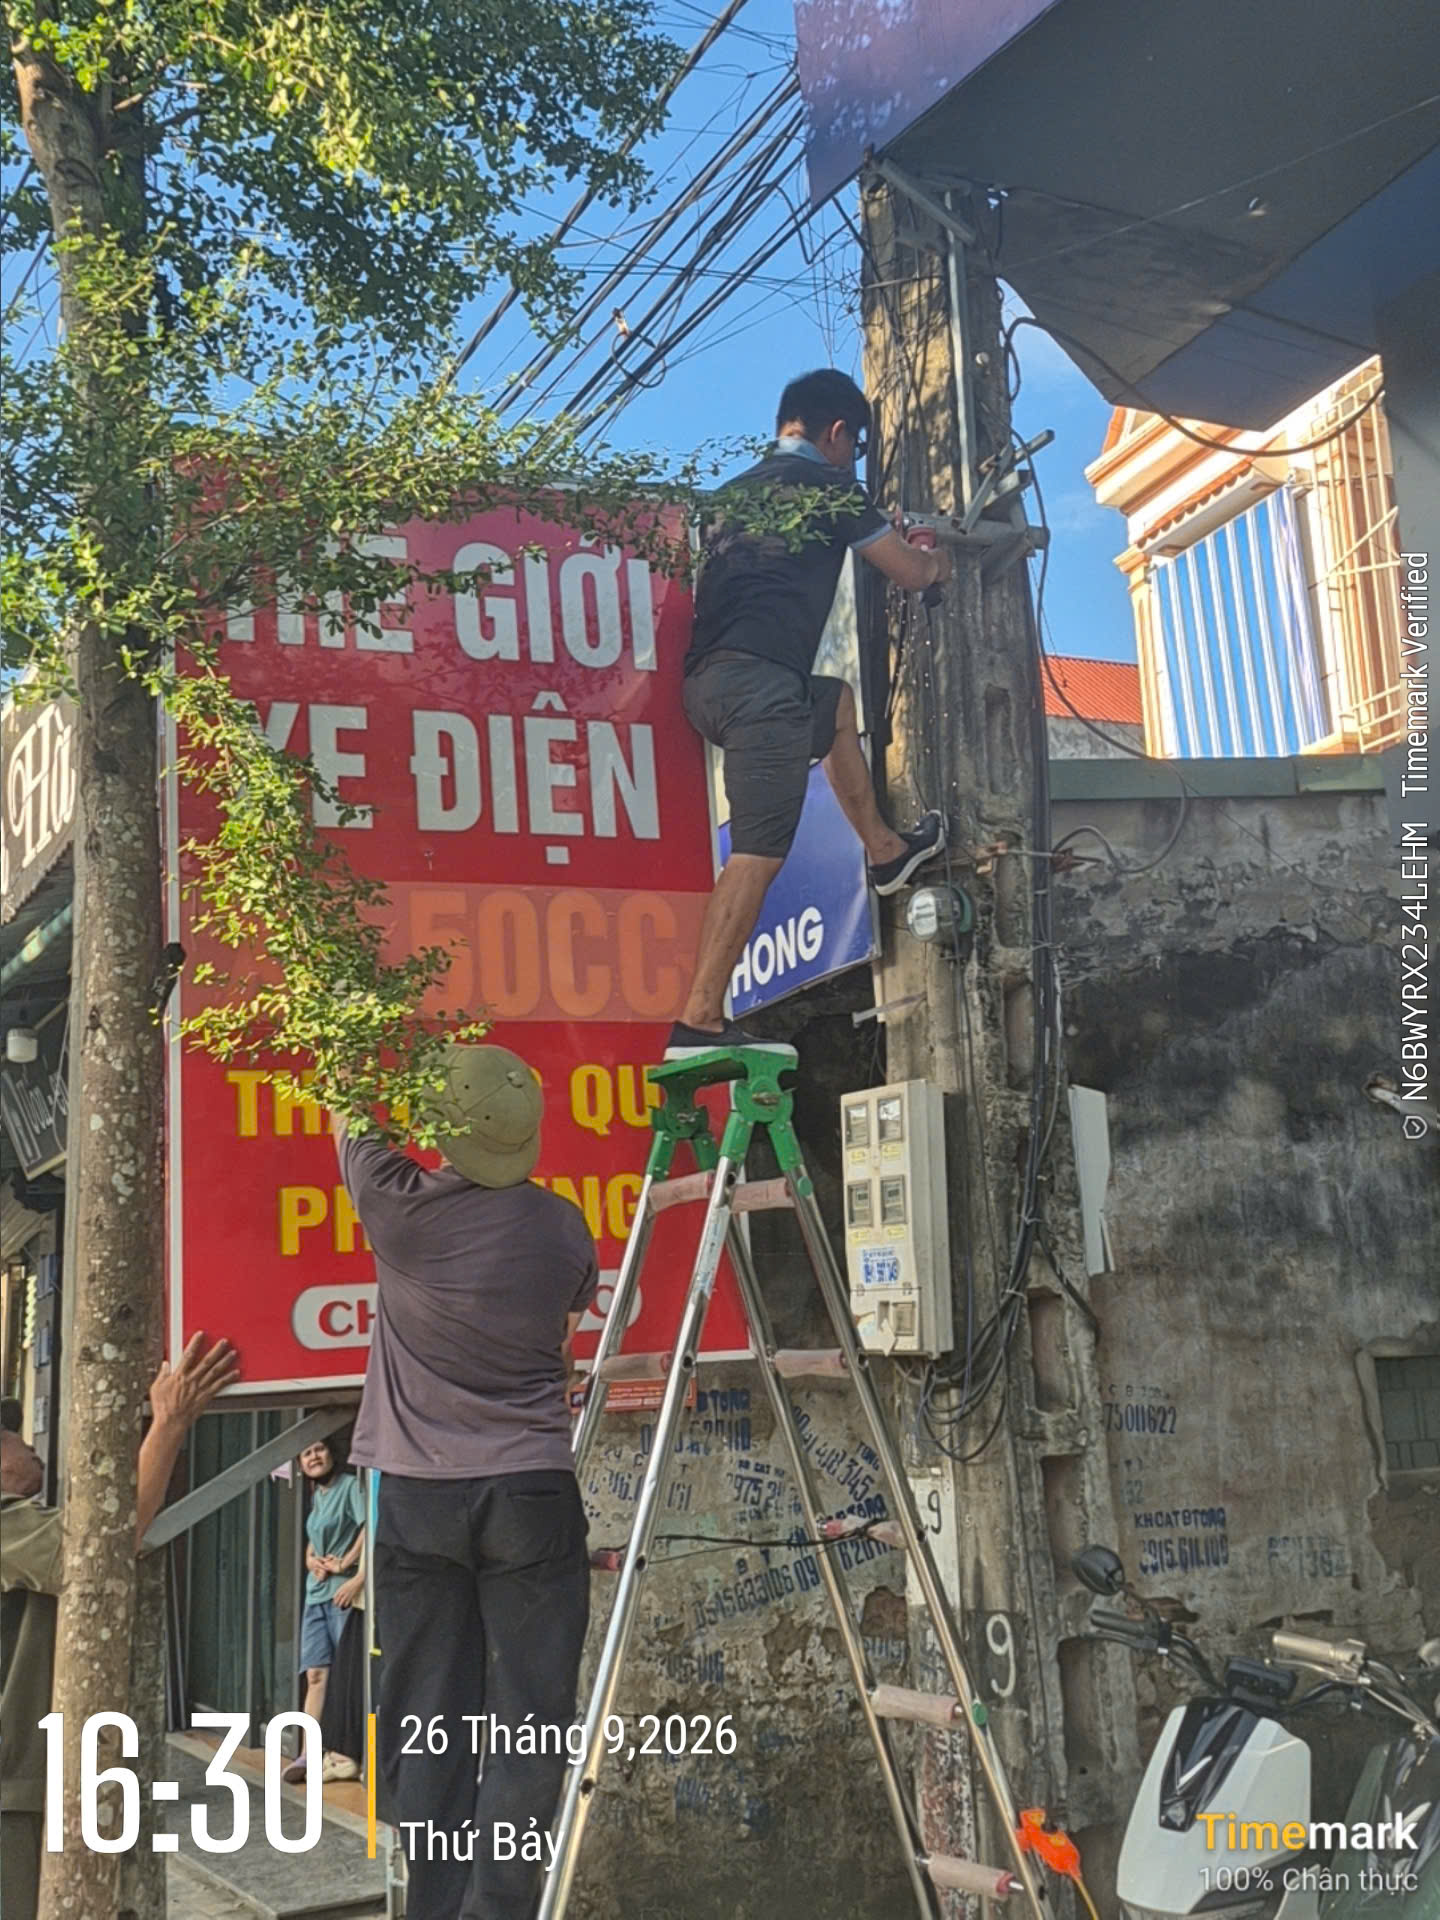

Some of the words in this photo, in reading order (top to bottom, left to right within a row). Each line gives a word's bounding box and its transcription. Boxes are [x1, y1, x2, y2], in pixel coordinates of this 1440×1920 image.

[453, 530, 657, 671] GIỚI
[411, 691, 660, 865] ĐIỆN
[409, 890, 682, 1016] 50CC
[985, 1613, 1016, 1698] 9
